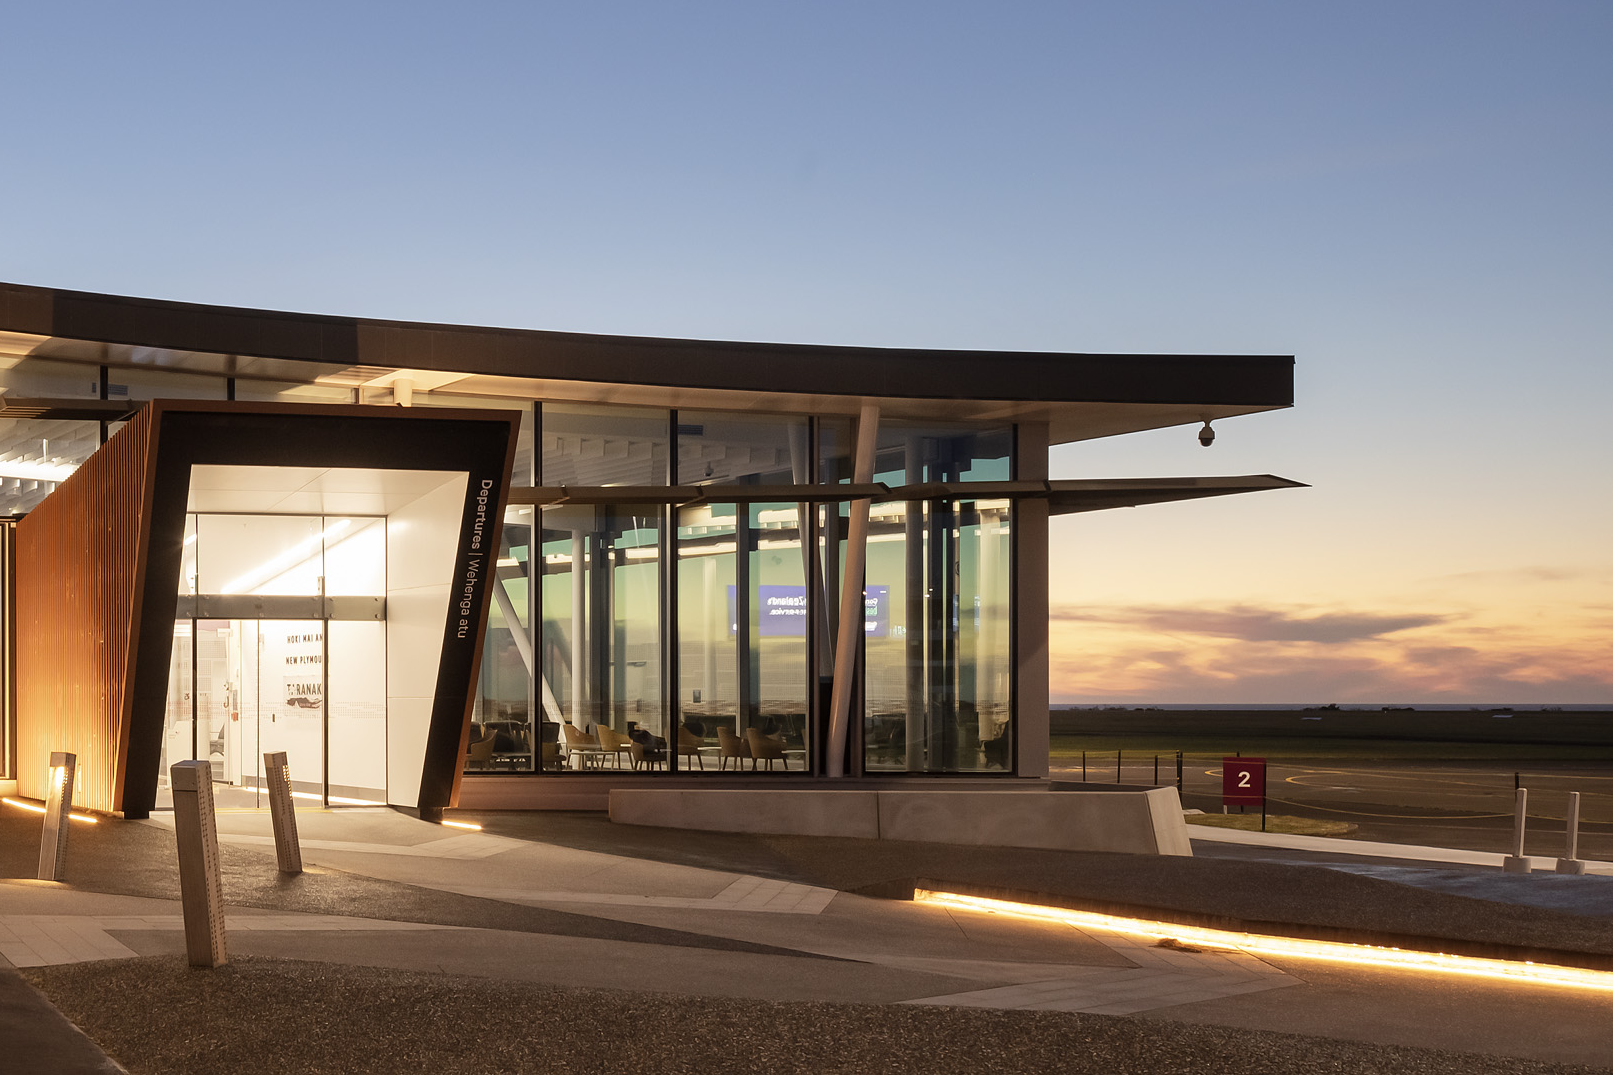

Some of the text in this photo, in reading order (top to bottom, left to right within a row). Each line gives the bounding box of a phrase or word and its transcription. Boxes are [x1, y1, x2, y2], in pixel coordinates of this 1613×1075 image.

[457, 479, 493, 639] Departures Wehenga atu
[315, 633, 323, 642] AN
[285, 655, 322, 665] NEW PLYMOU
[286, 683, 322, 696] TRANAK
[1238, 770, 1251, 788] 2
